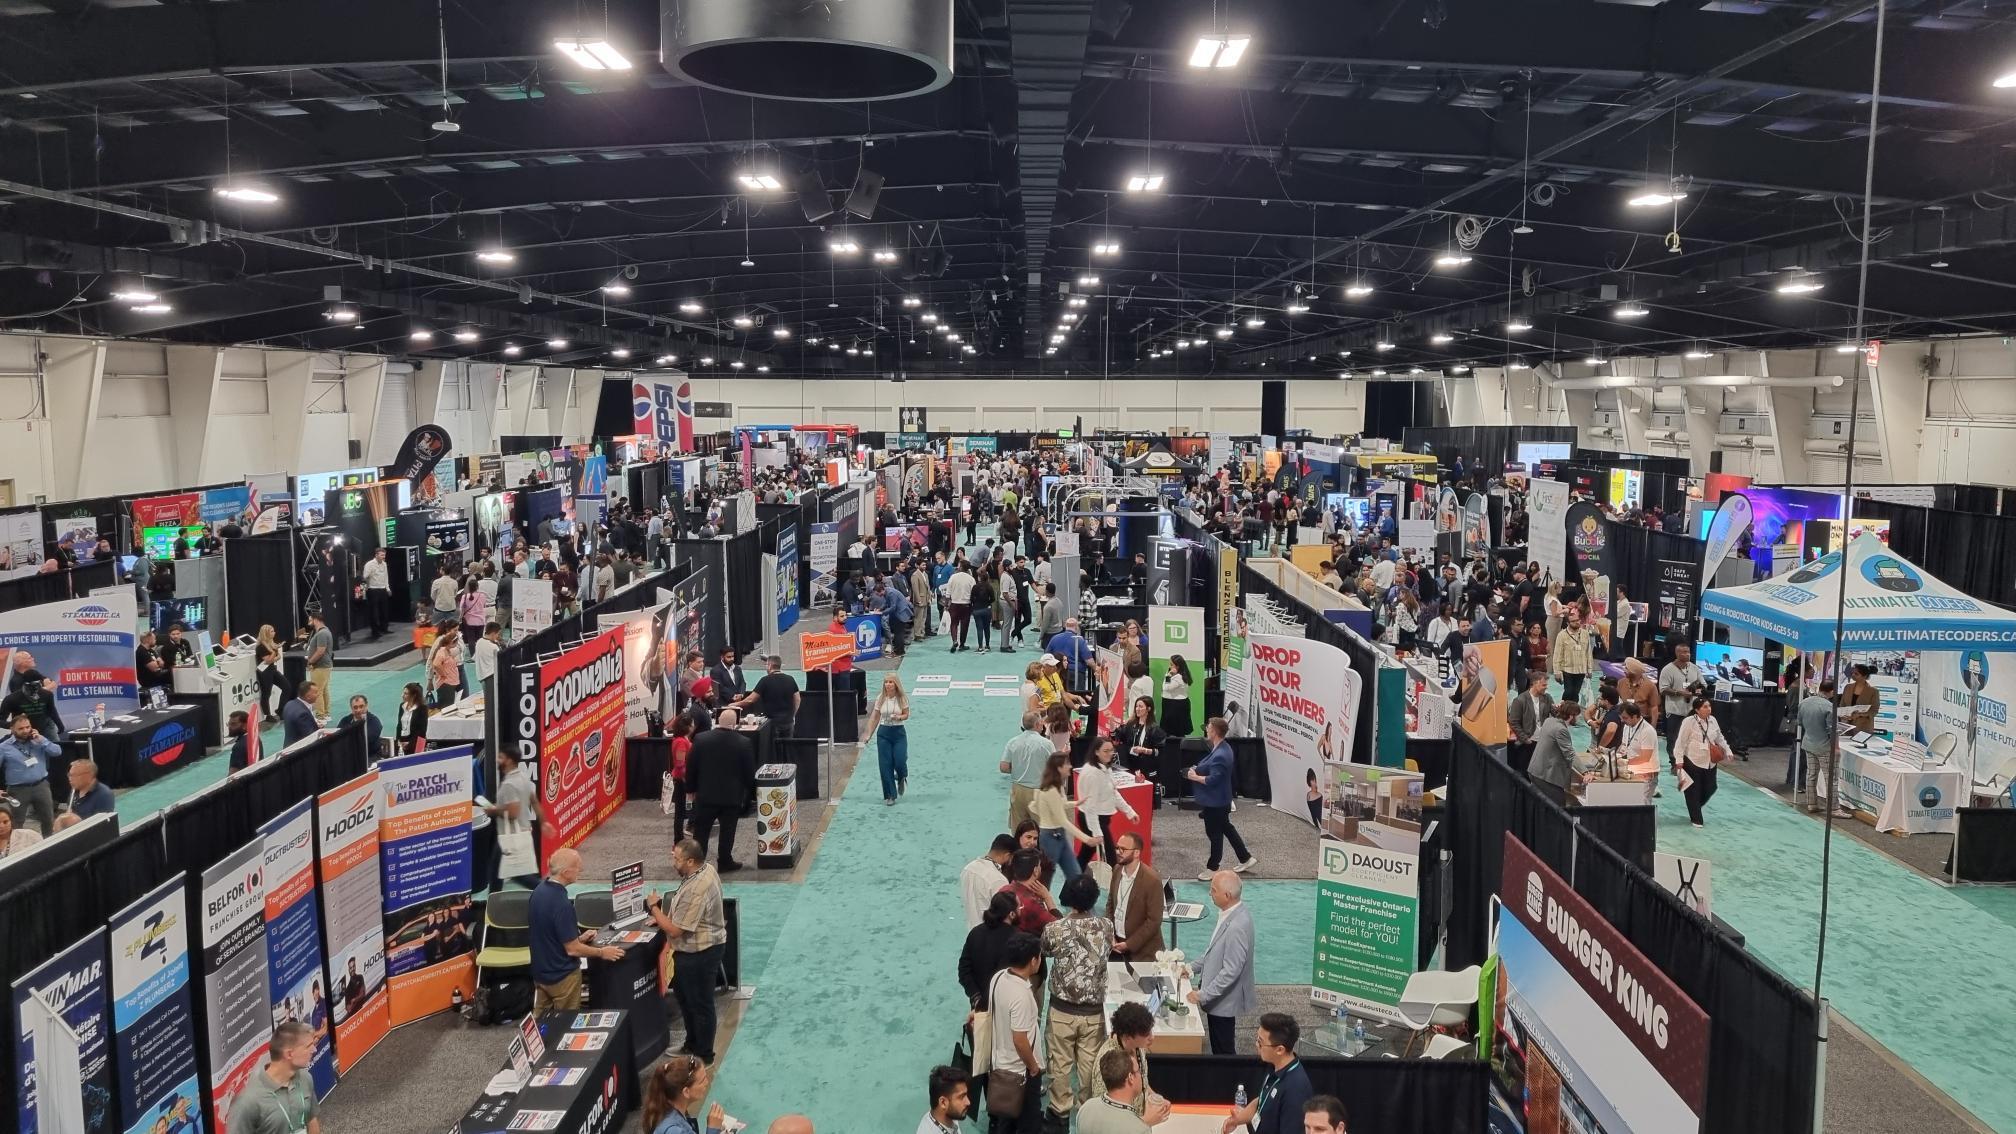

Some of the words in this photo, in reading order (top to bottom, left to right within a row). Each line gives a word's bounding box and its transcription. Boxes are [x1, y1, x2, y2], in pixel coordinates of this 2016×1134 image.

[654, 384, 676, 455] PEPSI
[1574, 535, 1605, 545] Bubble
[1844, 595, 1919, 608] ULTIMATE
[1920, 596, 1979, 611] CODERS
[1167, 624, 1186, 639] TD
[1704, 602, 1722, 615] CODING
[1722, 606, 1726, 615] &
[1727, 608, 1750, 621] ROBOTICS
[1751, 615, 1761, 624] FOR
[1761, 618, 1773, 630] KIDS
[1773, 622, 1786, 635] AGES
[1787, 627, 1799, 640] 5-18
[5, 636, 29, 644] CHOICE
[805, 641, 828, 649] Mister
[806, 643, 850, 656] transmission
[1252, 642, 1300, 667] DROP
[66, 671, 88, 681] DON'T
[91, 671, 112, 680] PANIC
[1256, 663, 1301, 692] YOUR
[62, 686, 81, 696] CALL
[84, 686, 123, 696] STEAMATIC
[1260, 684, 1325, 726] DRAWERS
[1922, 707, 1943, 720] LEARN
[1944, 714, 1951, 724] TO
[1943, 687, 1970, 709] ULTIMAT
[1977, 699, 2006, 722] CODERS
[546, 728, 559, 741] GREEK
[563, 711, 584, 732] CARIBBEAN
[586, 701, 599, 715] FUSION
[548, 732, 574, 753] RESTAURANT
[575, 719, 592, 736] CONCEPT
[600, 706, 610, 721] UNDER
[1264, 715, 1287, 729] EXPERIENCE
[138, 727, 195, 760] STEAMATIC.CA
[1984, 729, 1997, 742] THE
[1999, 731, 2016, 747] FUTU
[395, 781, 407, 792] The
[408, 771, 447, 790] PATCH
[396, 779, 460, 805] AUTHORITY
[554, 803, 563, 815] WHY
[564, 790, 577, 807] SETTLE
[588, 772, 600, 788] BRAND
[1862, 776, 1885, 800] CODERS
[325, 802, 375, 842] HOODZ
[387, 819, 402, 830] Top
[403, 811, 432, 825] Benefits
[433, 809, 441, 818] of
[443, 804, 466, 818] Joining
[394, 826, 407, 836] The
[408, 821, 428, 832] Patch
[430, 813, 462, 829] Authority
[559, 811, 570, 825] WHEN
[571, 805, 579, 818] YOU
[562, 815, 578, 836] BRANDS
[579, 806, 588, 822] WITH
[574, 815, 597, 842] AVAILABLE
[598, 802, 612, 822] NATION
[613, 793, 624, 809] WIDE
[264, 830, 308, 866] DUCTBUSTERS
[346, 850, 362, 867] HOODZ
[328, 854, 338, 869] Top
[616, 868, 632, 878] BELFOR
[1352, 853, 1412, 875] DAOUST
[208, 880, 244, 918] BELFOR
[268, 892, 279, 907] Top
[1322, 888, 1331, 896] Be
[1347, 895, 1381, 907] exclusive
[1383, 901, 1410, 912] Ontario
[1527, 882, 1543, 902] BURGER
[1527, 892, 1543, 915] KING
[210, 902, 243, 934] FRANCHISE
[1334, 899, 1359, 910] Master
[1360, 905, 1397, 919] Franchise
[219, 937, 230, 953] JOIN
[231, 928, 242, 943] OUR
[242, 915, 260, 935] FAMILY
[1331, 912, 1348, 923] Find
[1351, 917, 1366, 927] the
[1368, 922, 1400, 935] perfect
[1331, 924, 1358, 936] model
[1361, 930, 1373, 938] for
[1376, 931, 1398, 944] YOU!
[215, 953, 223, 967] OF
[223, 938, 243, 960] SERVICE
[244, 922, 264, 944] BRANDS
[1331, 936, 1347, 945] Daoust
[1348, 940, 1375, 951] EcoExpress
[1546, 896, 1613, 993] BURGER
[1616, 964, 1669, 1049] KING
[125, 994, 136, 1010] Top
[137, 979, 159, 1001] Benefits
[160, 974, 166, 984] of
[144, 978, 175, 1006] PLUMBERZ
[1545, 1040, 1561, 1067] SINCE
[579, 1094, 603, 1134] ELFOR
